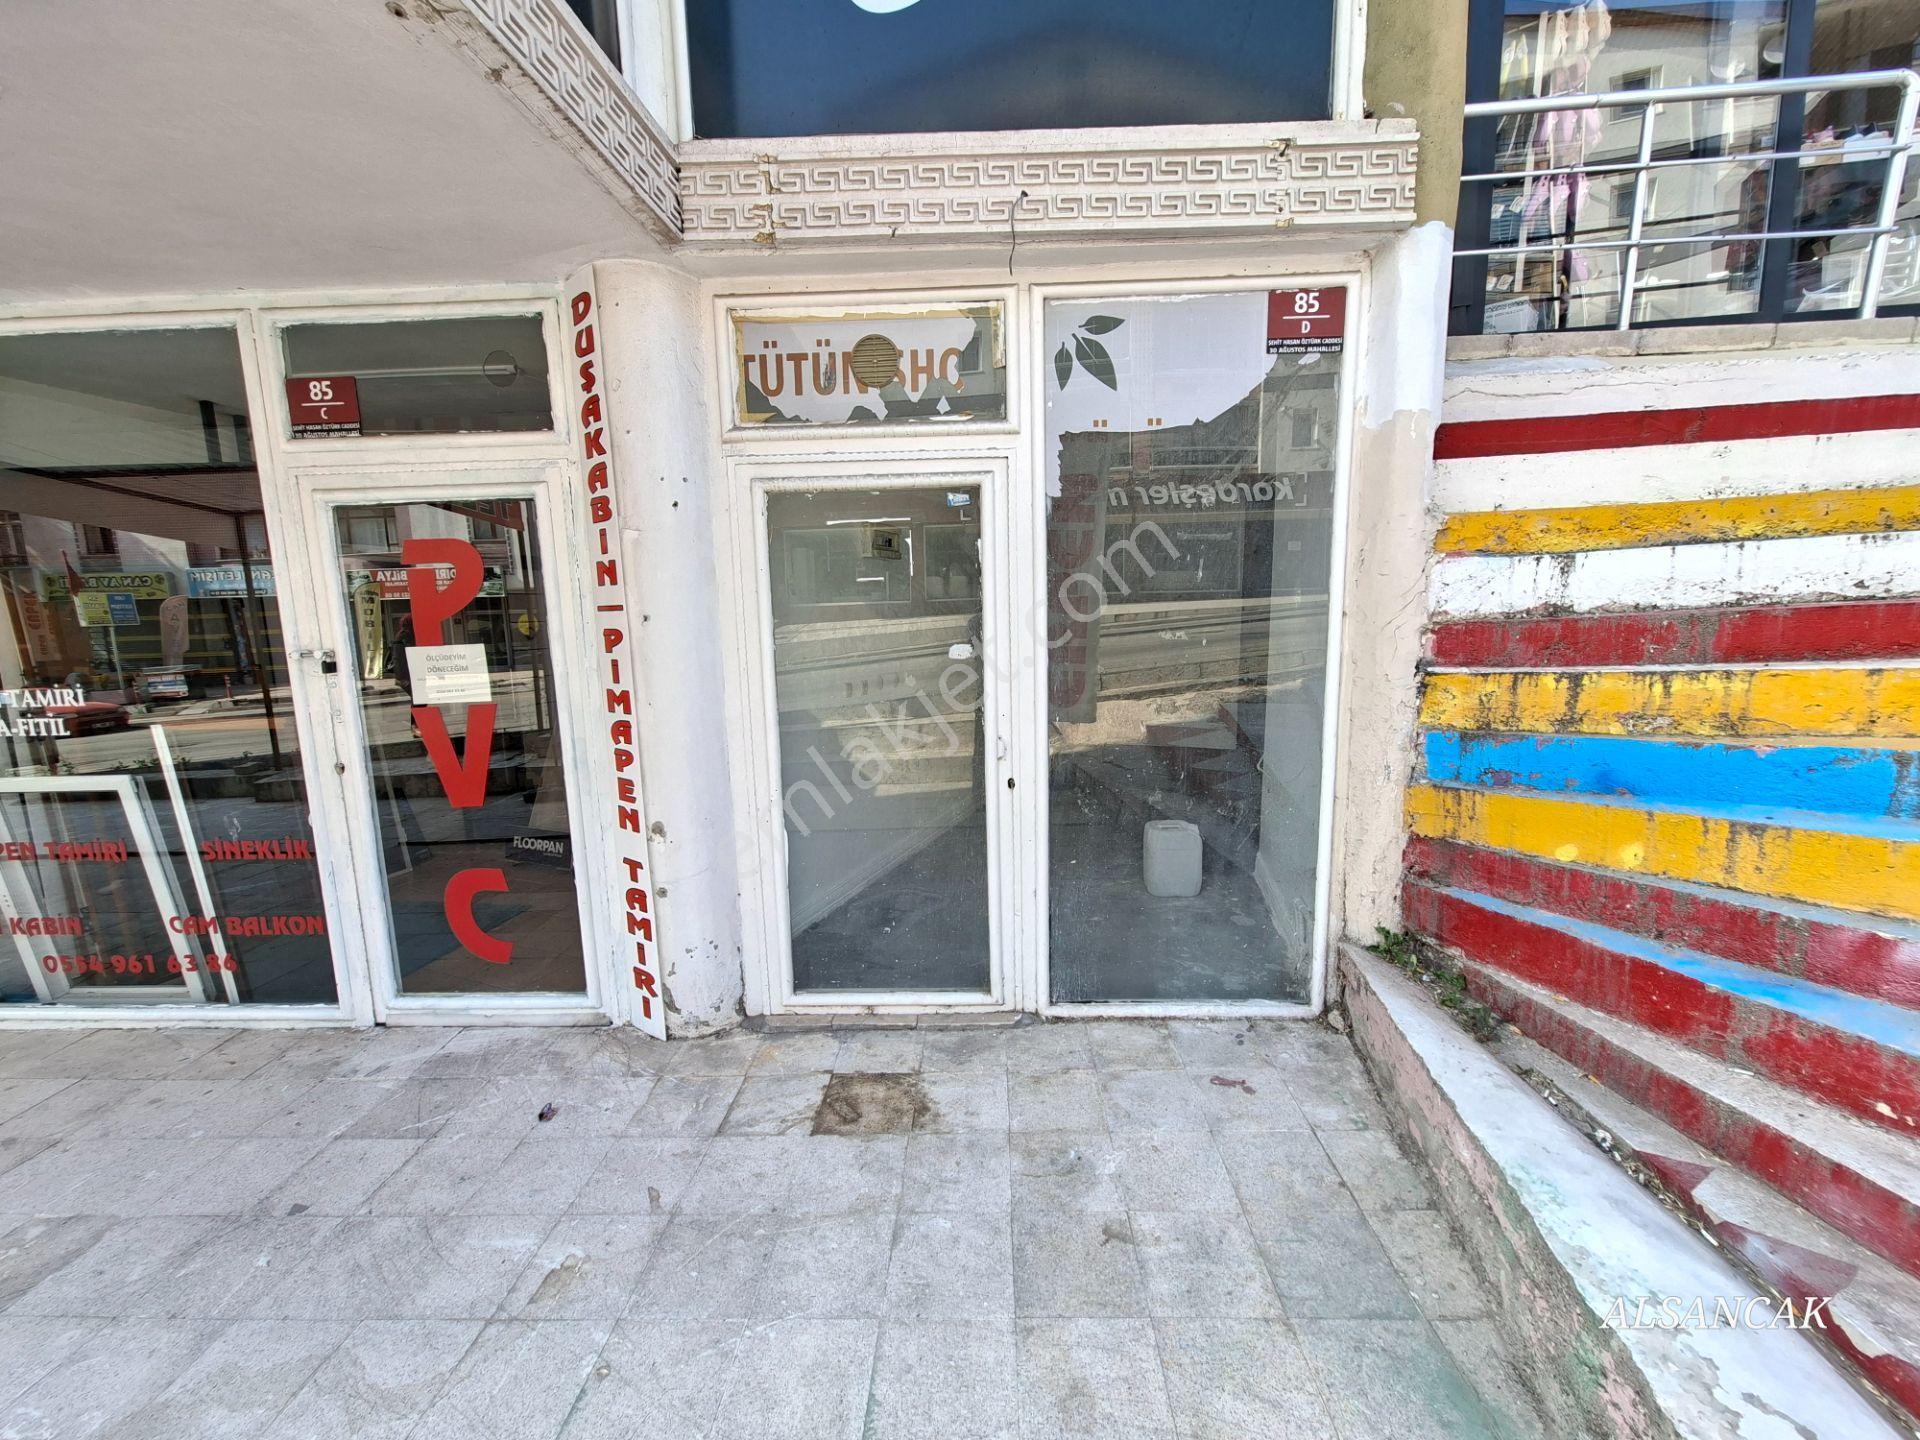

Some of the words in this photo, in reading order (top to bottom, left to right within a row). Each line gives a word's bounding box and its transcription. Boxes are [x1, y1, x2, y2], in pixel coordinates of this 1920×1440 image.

[1294, 292, 1320, 313] 85
[1301, 320, 1311, 334] D
[1278, 345, 1306, 353] AĞUSTOS
[1307, 344, 1341, 352] MAHALLESİ
[309, 381, 333, 401] 85
[320, 407, 329, 420] C
[201, 836, 313, 861] SİNEKLİK
[513, 835, 564, 854] FLOORPAN
[169, 915, 219, 936] CAM
[225, 915, 326, 937] BALKON
[111, 953, 156, 974] 961
[167, 954, 198, 974] 63
